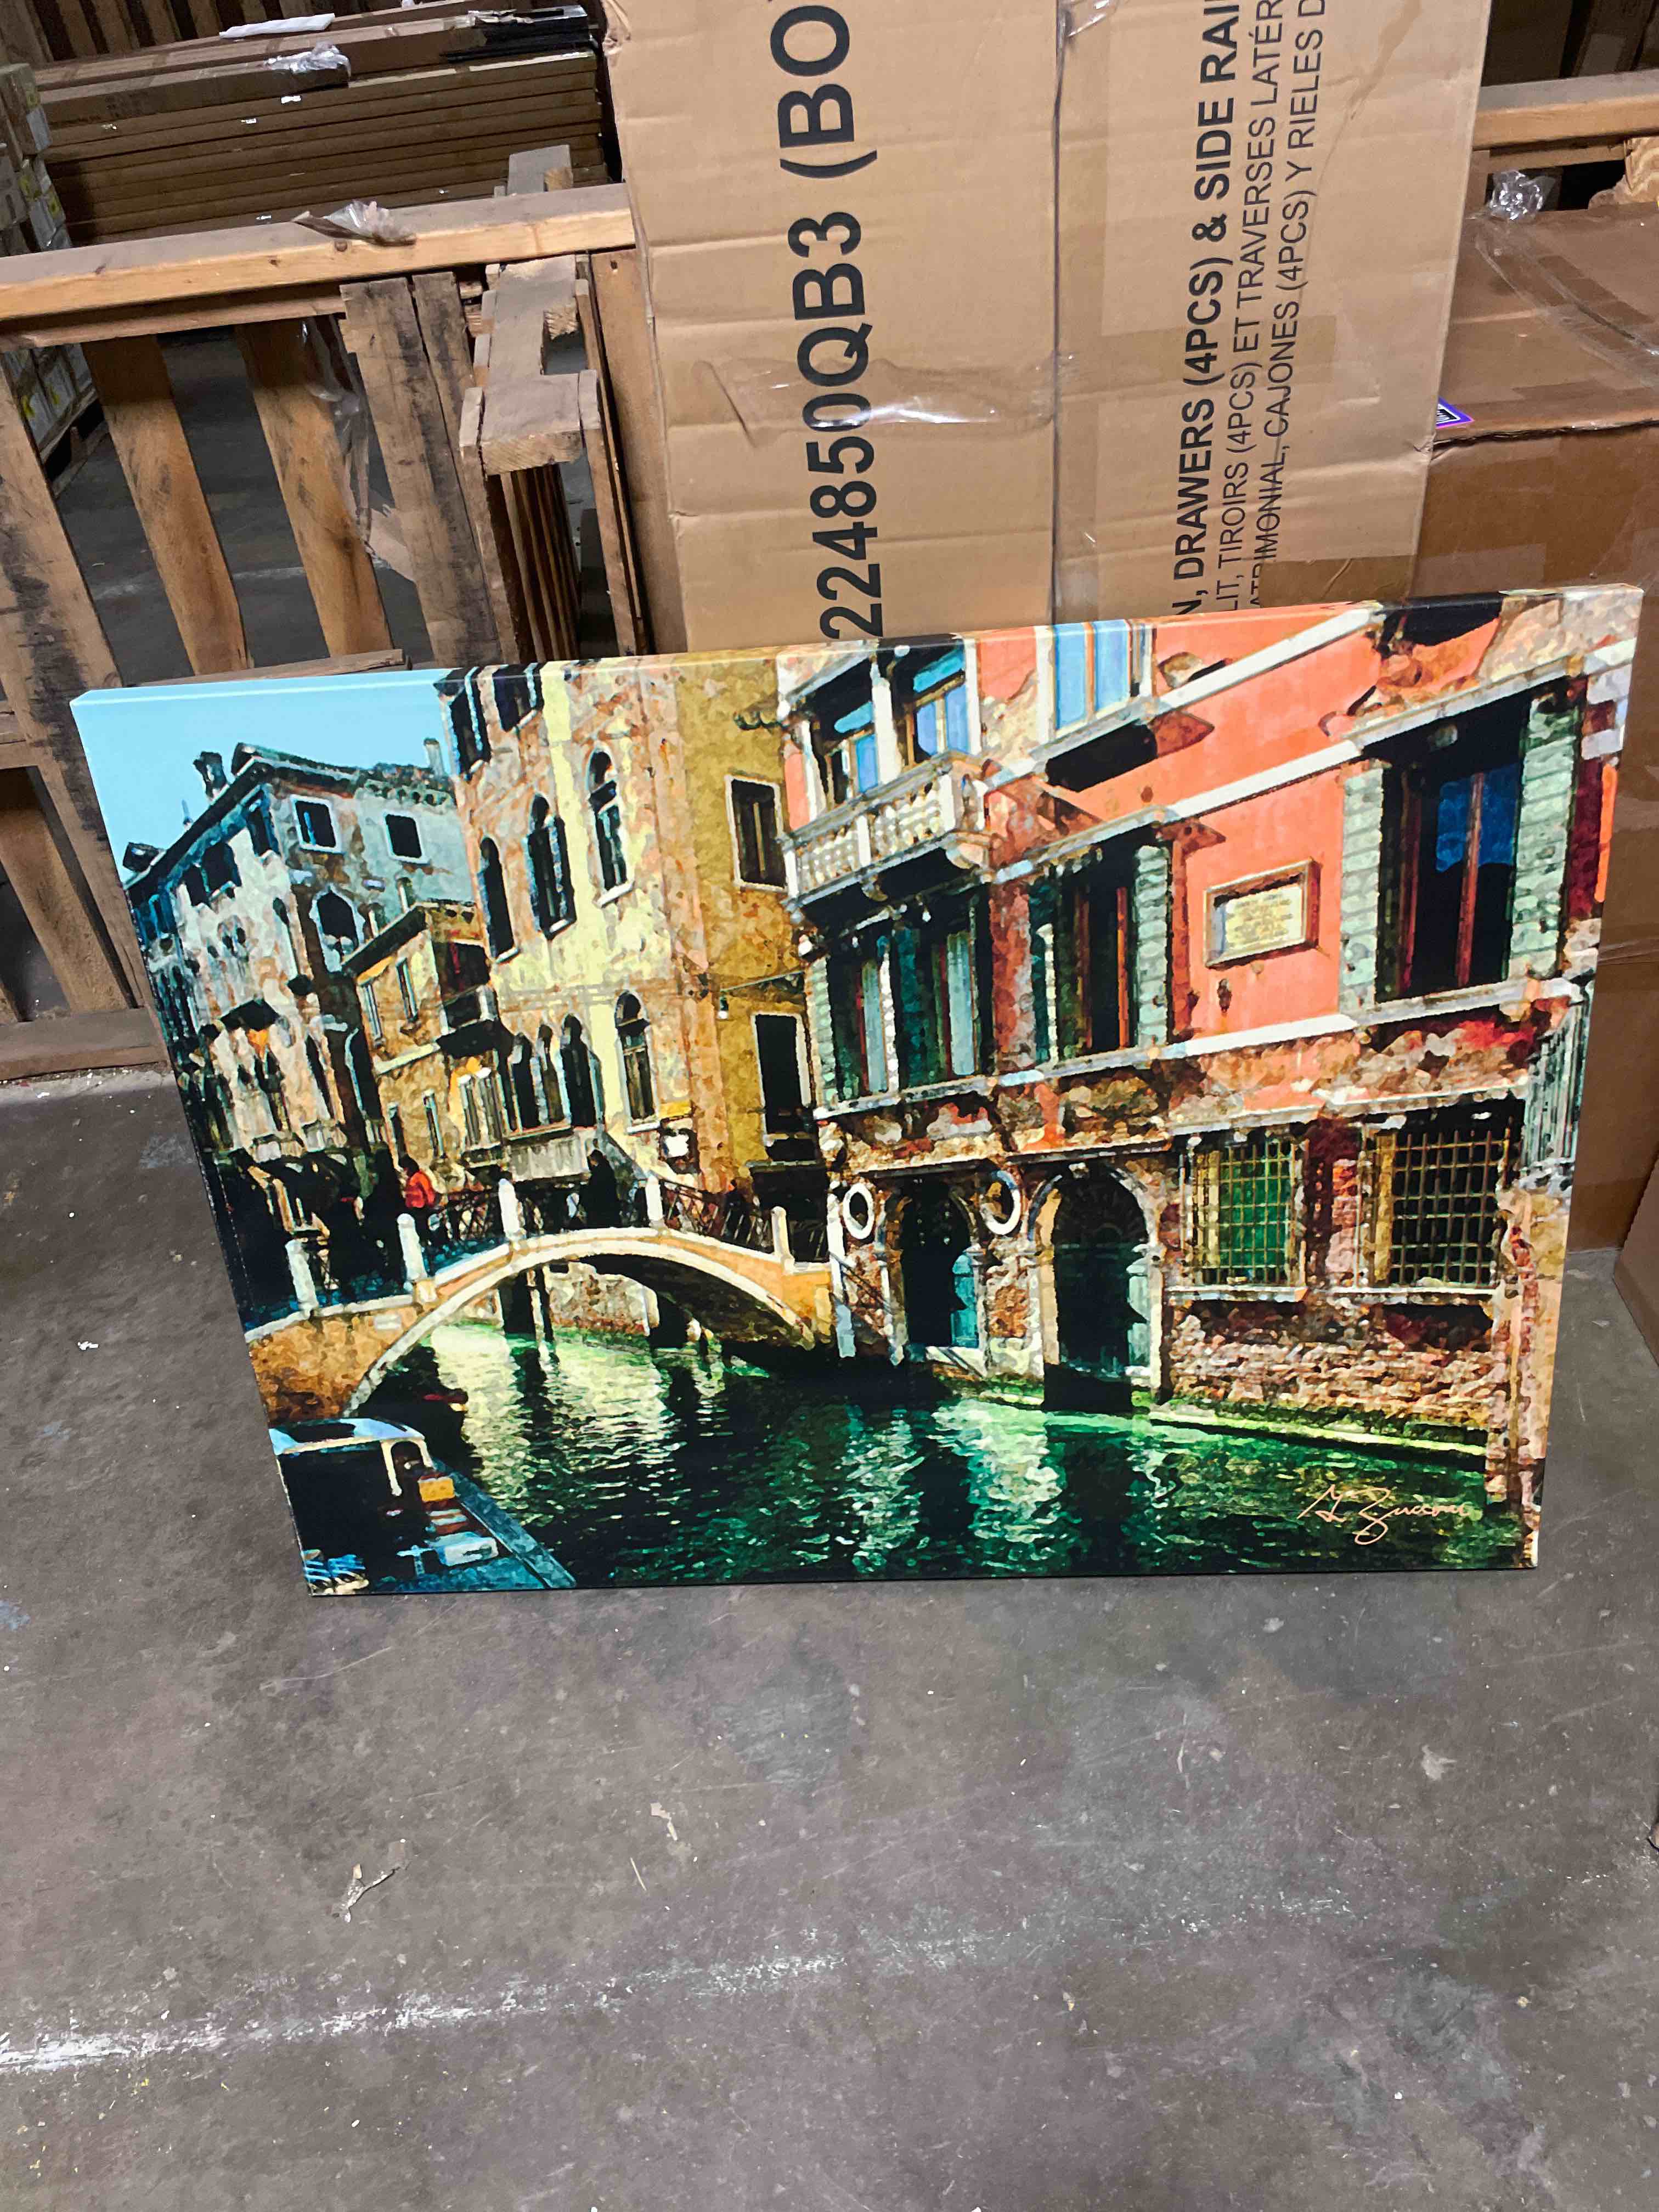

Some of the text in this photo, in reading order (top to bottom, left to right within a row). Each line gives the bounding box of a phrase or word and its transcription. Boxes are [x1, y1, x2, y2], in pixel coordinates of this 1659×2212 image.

[1200, 0, 1239, 83] RAI
[1288, 29, 1323, 149] RIELES
[1194, 98, 1234, 200] SIDE
[1285, 161, 1312, 182] Y
[1192, 213, 1227, 242] &
[1237, 116, 1276, 308] TRAVERSES
[1276, 190, 1317, 291] (4PCS)
[768, 0, 883, 639] 224850QB3 (BO
[1183, 258, 1234, 386] (4PCS)
[1233, 317, 1260, 352] ET
[1264, 301, 1300, 437] CAJONES
[1226, 363, 1262, 453] (4PCS)
[1174, 399, 1214, 579] DRAWERS
[1218, 462, 1249, 568] TIROIRS
